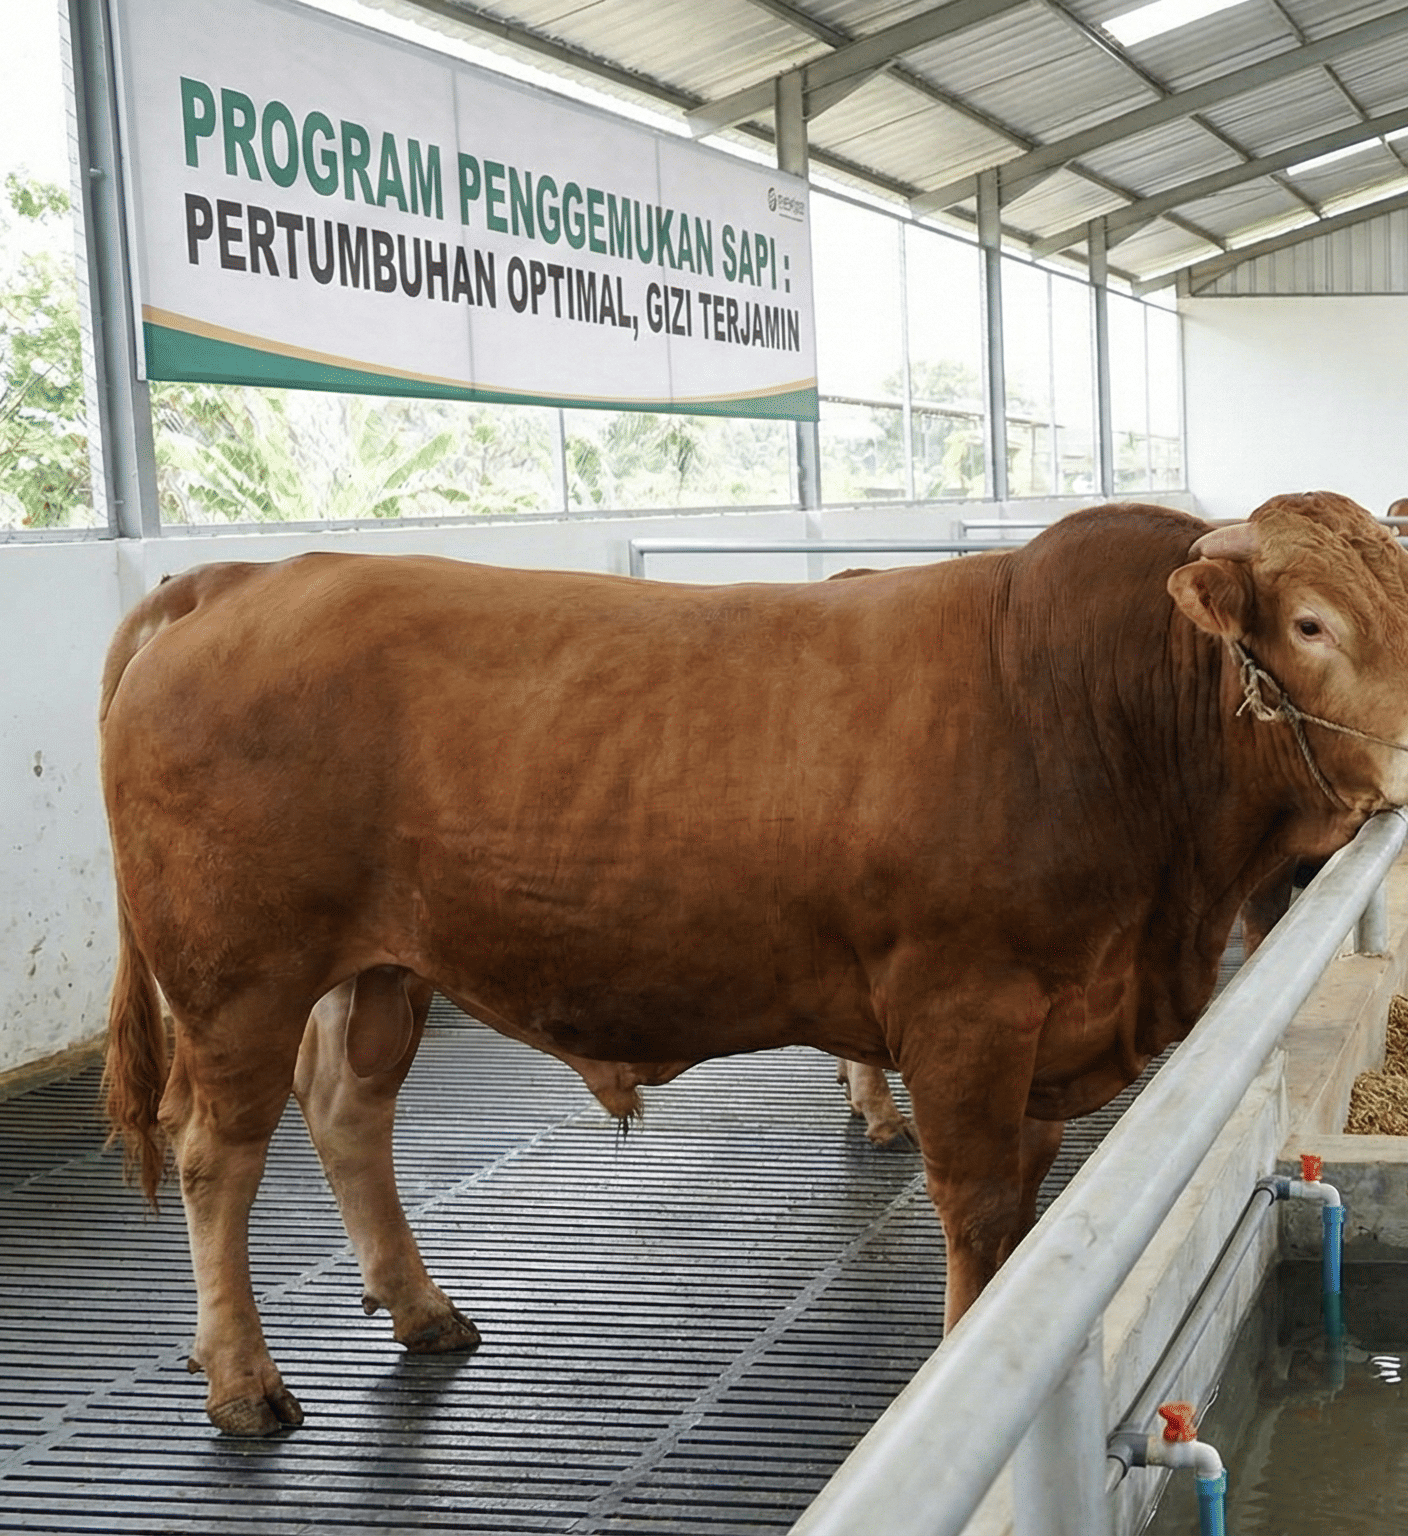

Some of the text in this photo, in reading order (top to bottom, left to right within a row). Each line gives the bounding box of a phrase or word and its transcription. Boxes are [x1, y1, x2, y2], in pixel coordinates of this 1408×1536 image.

[180, 76, 444, 221] PROGRAM
[457, 151, 714, 277] PENGGEMUKAN
[722, 224, 777, 290] SAPI
[184, 192, 800, 352] PERTUMBUHAN OPTIMAL, GIZI TERJAMIN
